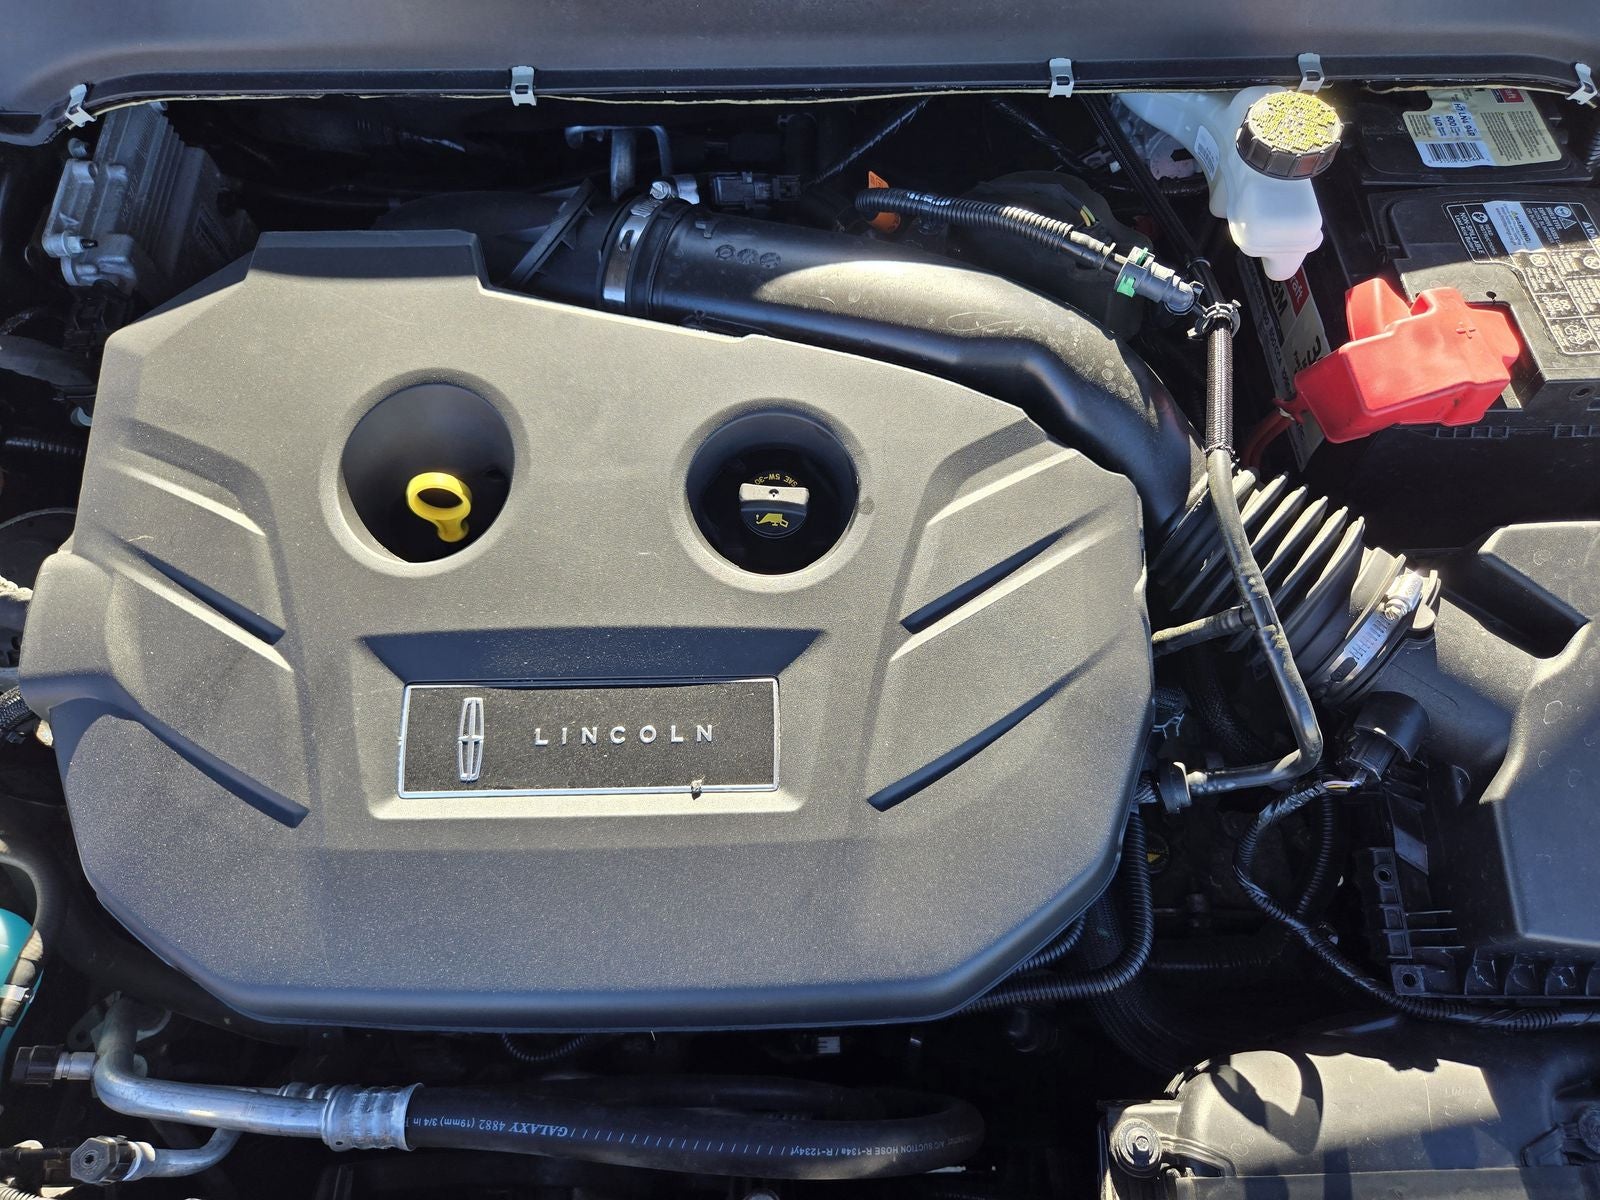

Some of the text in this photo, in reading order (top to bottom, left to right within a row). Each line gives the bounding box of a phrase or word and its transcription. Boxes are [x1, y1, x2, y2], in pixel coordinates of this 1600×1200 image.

[754, 473, 798, 487] SAE 5W-30
[534, 724, 714, 746] LINCOLN
[424, 1117, 438, 1127] 3/4
[440, 1116, 476, 1129] (19mm)
[479, 1119, 506, 1131] 4882
[508, 1122, 568, 1137] GALAXY
[790, 1146, 832, 1156] R-1234yf
[841, 1147, 872, 1156] R-134a
[874, 1146, 898, 1155] HOSE
[900, 1142, 932, 1153] SUCTION
